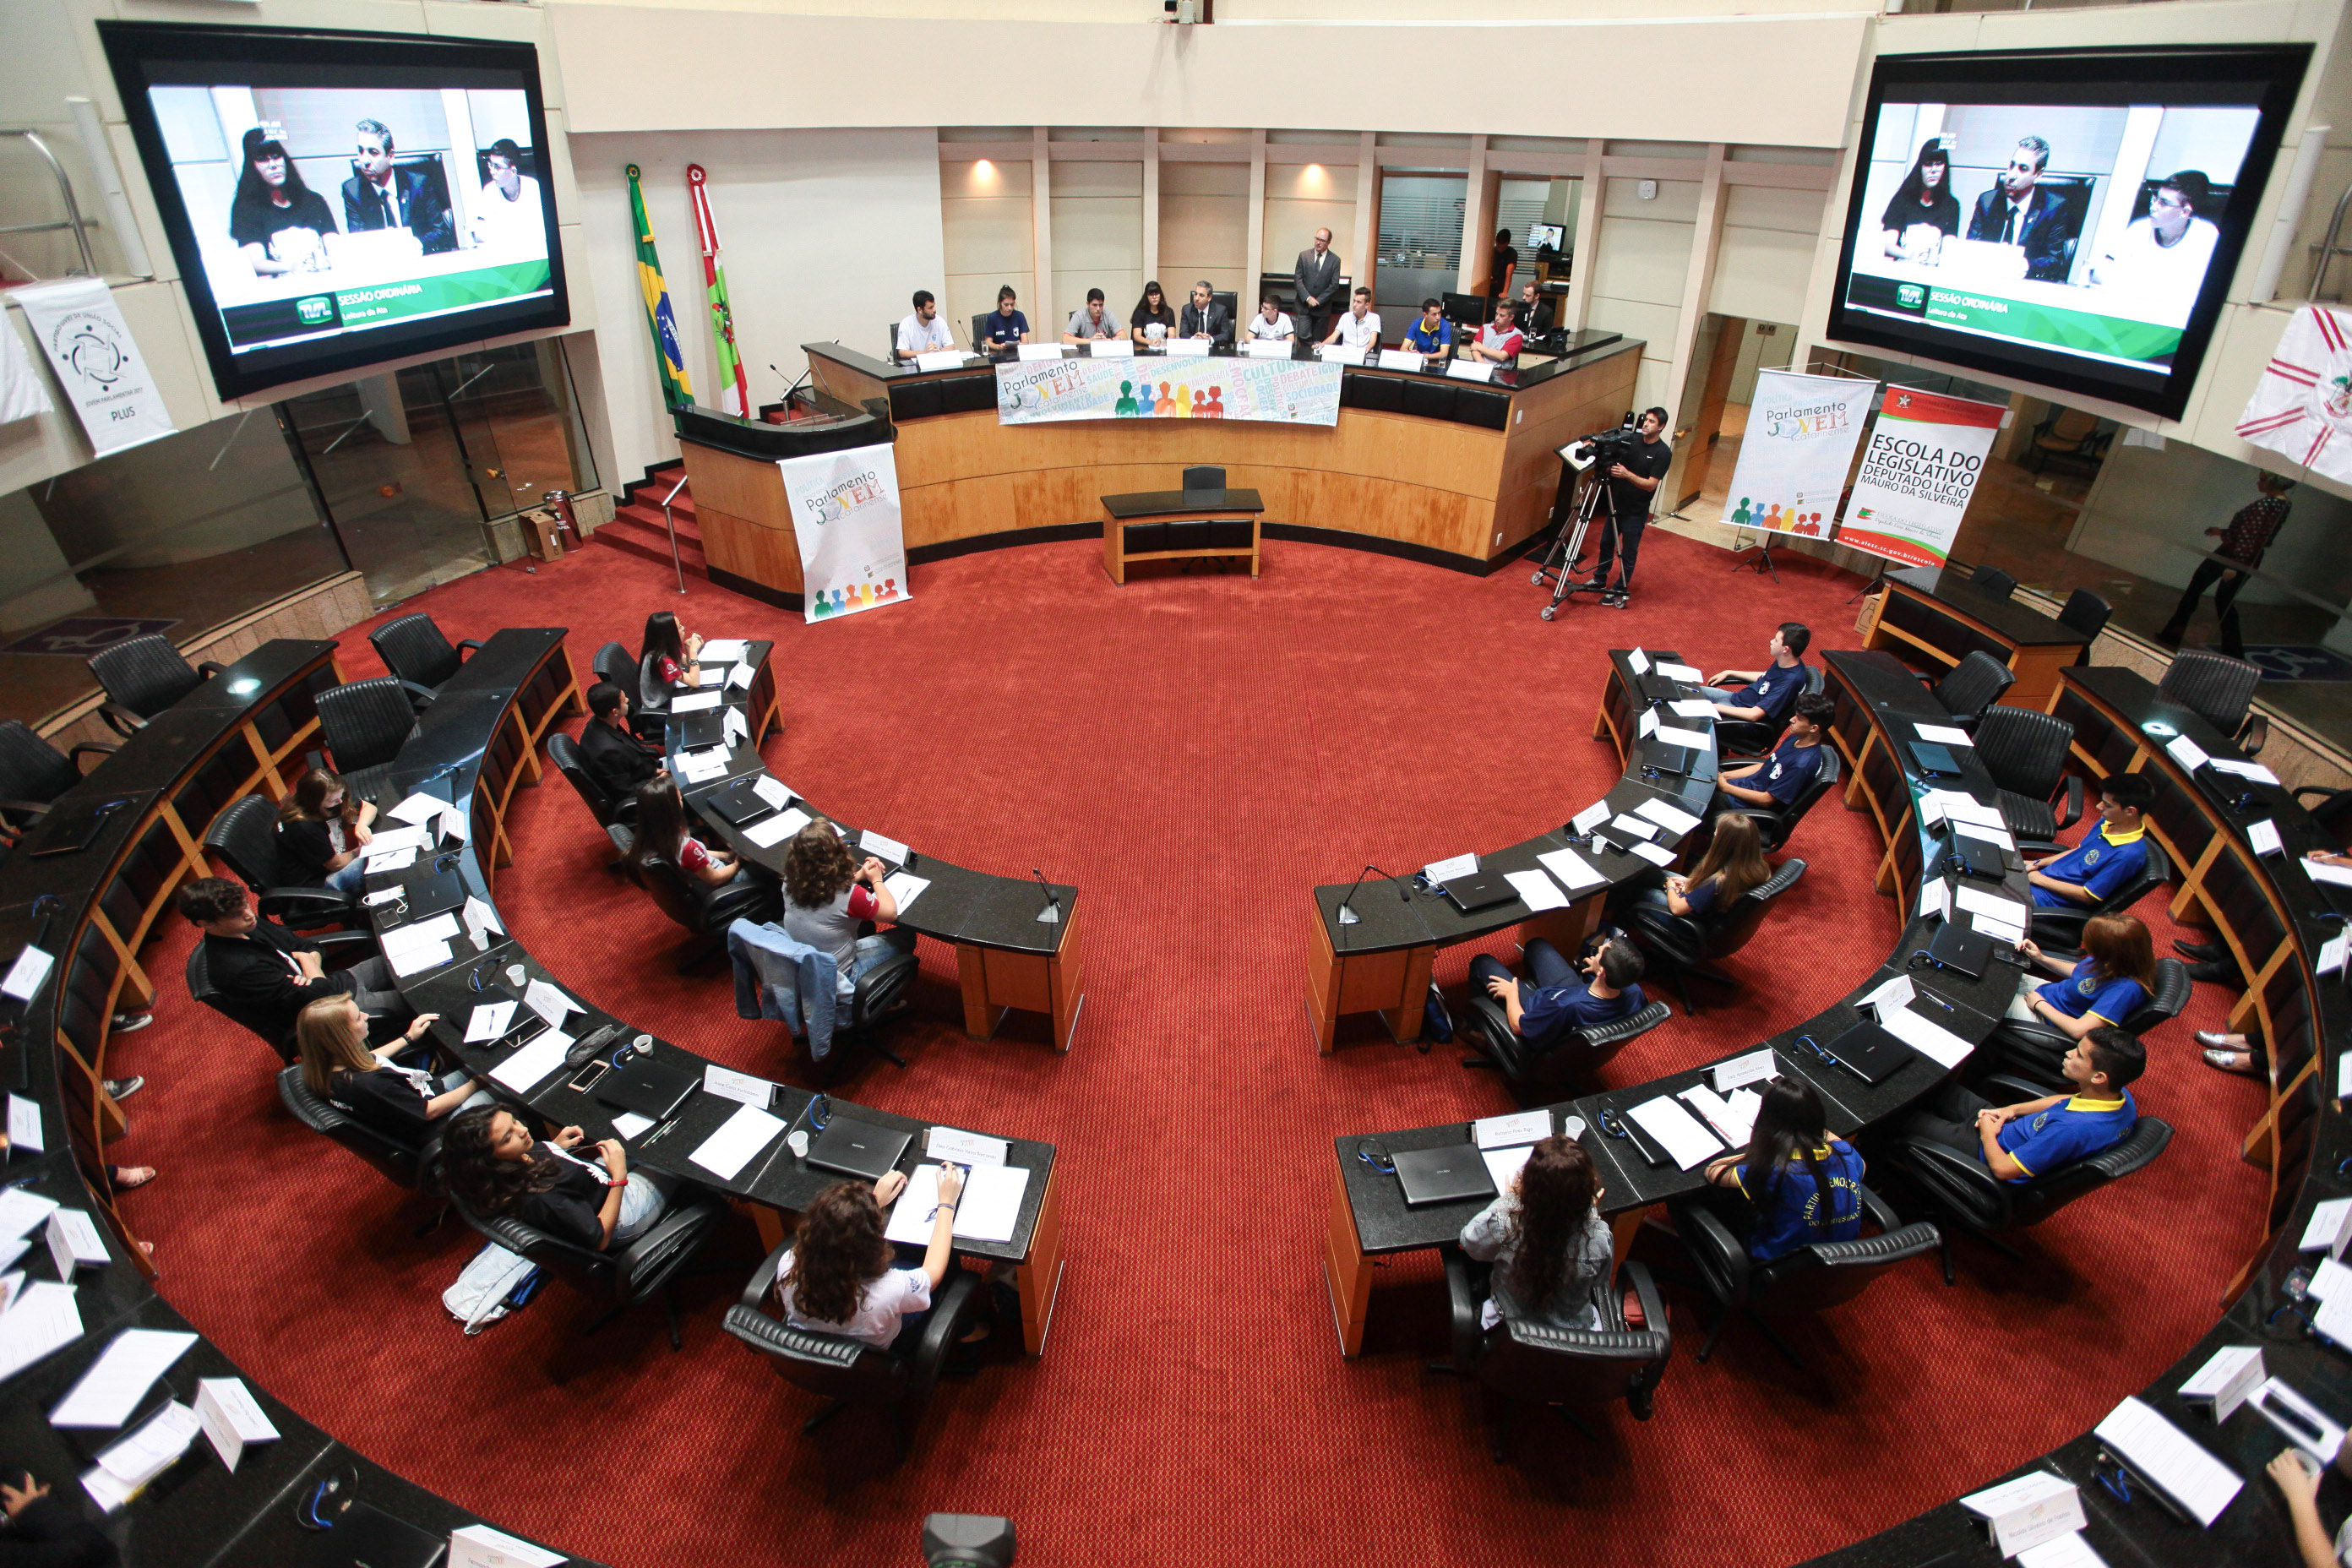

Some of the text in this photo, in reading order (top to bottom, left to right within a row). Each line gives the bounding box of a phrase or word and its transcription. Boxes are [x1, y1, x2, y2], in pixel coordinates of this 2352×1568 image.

[338, 284, 423, 306] SESSÃO ORDINÁRIA
[1930, 291, 2008, 313] SESSÃO ORDINÁRIA
[342, 310, 367, 321] Leitura
[367, 308, 376, 317] da
[1928, 307, 1968, 320] Leitura da Ata
[102, 318, 122, 338] SOCIAL
[1004, 361, 1078, 394] Parlamento
[1081, 359, 1111, 375] DEBATE
[1243, 360, 1307, 382] CULTURA
[1280, 367, 1318, 384] DEBATE
[101, 389, 133, 404] PARLAMENTAR
[1010, 369, 1086, 409] JOVEM
[1282, 380, 1315, 392] CULTURA
[1285, 382, 1339, 402] SOCIEDADE
[1038, 387, 1088, 410] catarinense
[111, 406, 136, 422] PLUS
[1767, 402, 1847, 422] Parlamento
[1767, 411, 1849, 439] JOVEM
[1794, 427, 1849, 442] catarinense
[1872, 433, 1981, 471] ESCOLA DO
[1867, 449, 1974, 487] LEGISLATIVO
[805, 471, 876, 511] Parlamento
[1860, 475, 1963, 509] MAURO DA SILVEIRA
[1864, 464, 1968, 499] DEPUTADO LÍCIO
[816, 478, 885, 525] JOVEM
[839, 493, 887, 520] catarinense
[1876, 511, 1897, 521] ESCOLA
[1908, 520, 1945, 534] LEGISLATIVO
[1844, 535, 1936, 567] www.alesc.sc.gov.br/escola
[1803, 1192, 1821, 1221] PARTID
